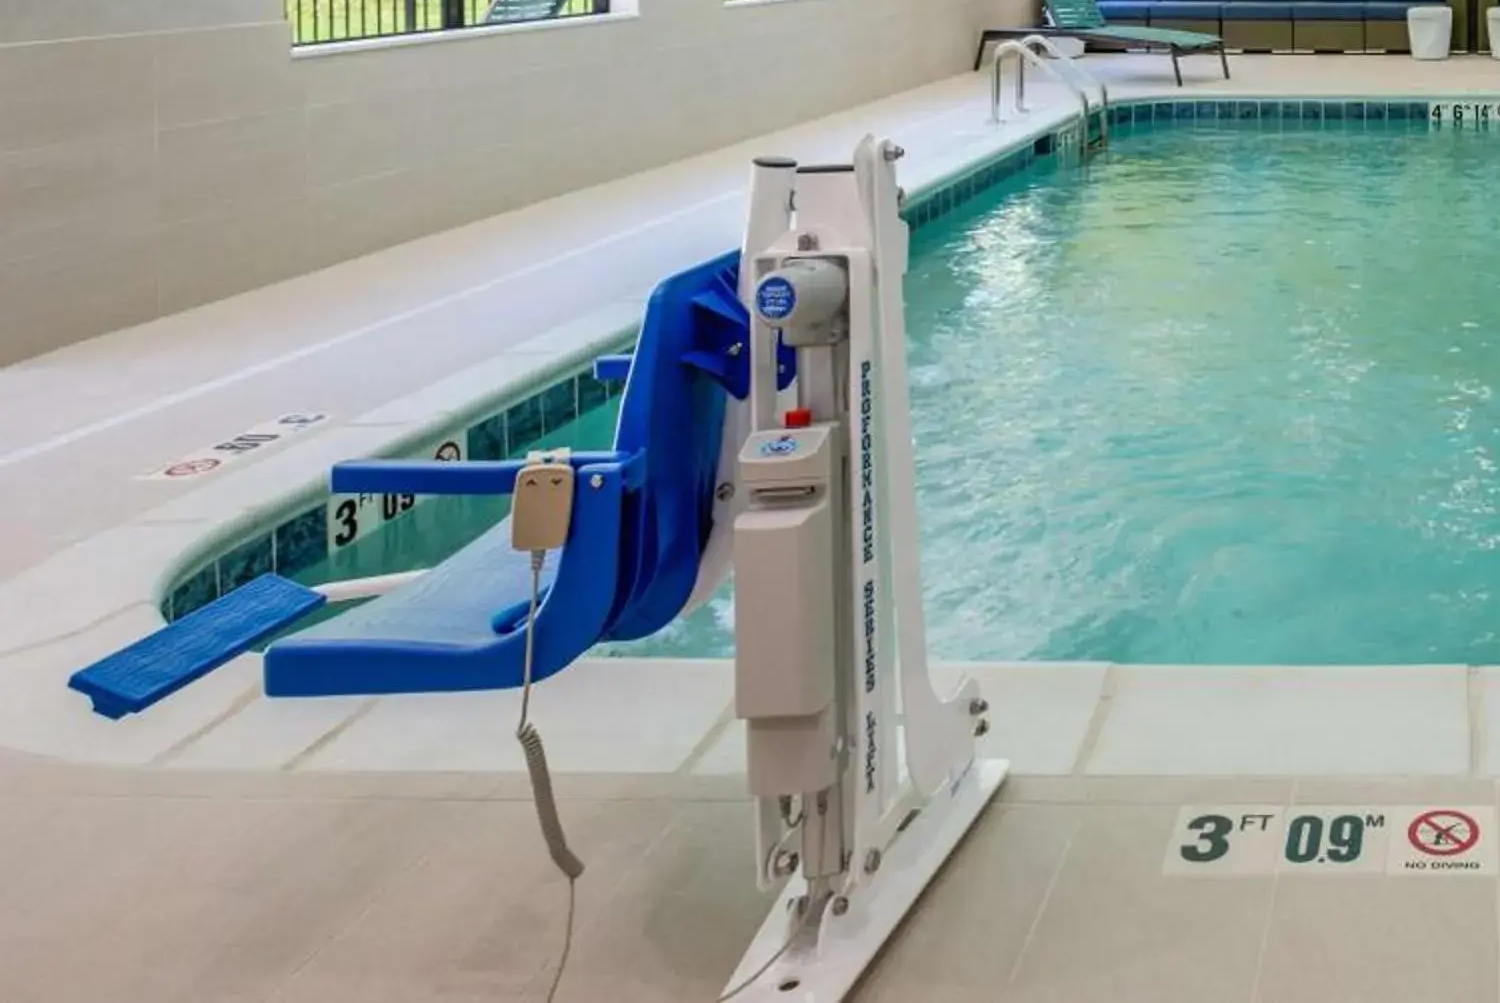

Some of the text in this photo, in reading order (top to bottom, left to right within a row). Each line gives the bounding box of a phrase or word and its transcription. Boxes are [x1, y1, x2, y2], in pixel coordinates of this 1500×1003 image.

[335, 498, 357, 547] 3
[1180, 814, 1385, 863] 3 FT 0.9 M
[1405, 861, 1481, 870] NO DIVING
